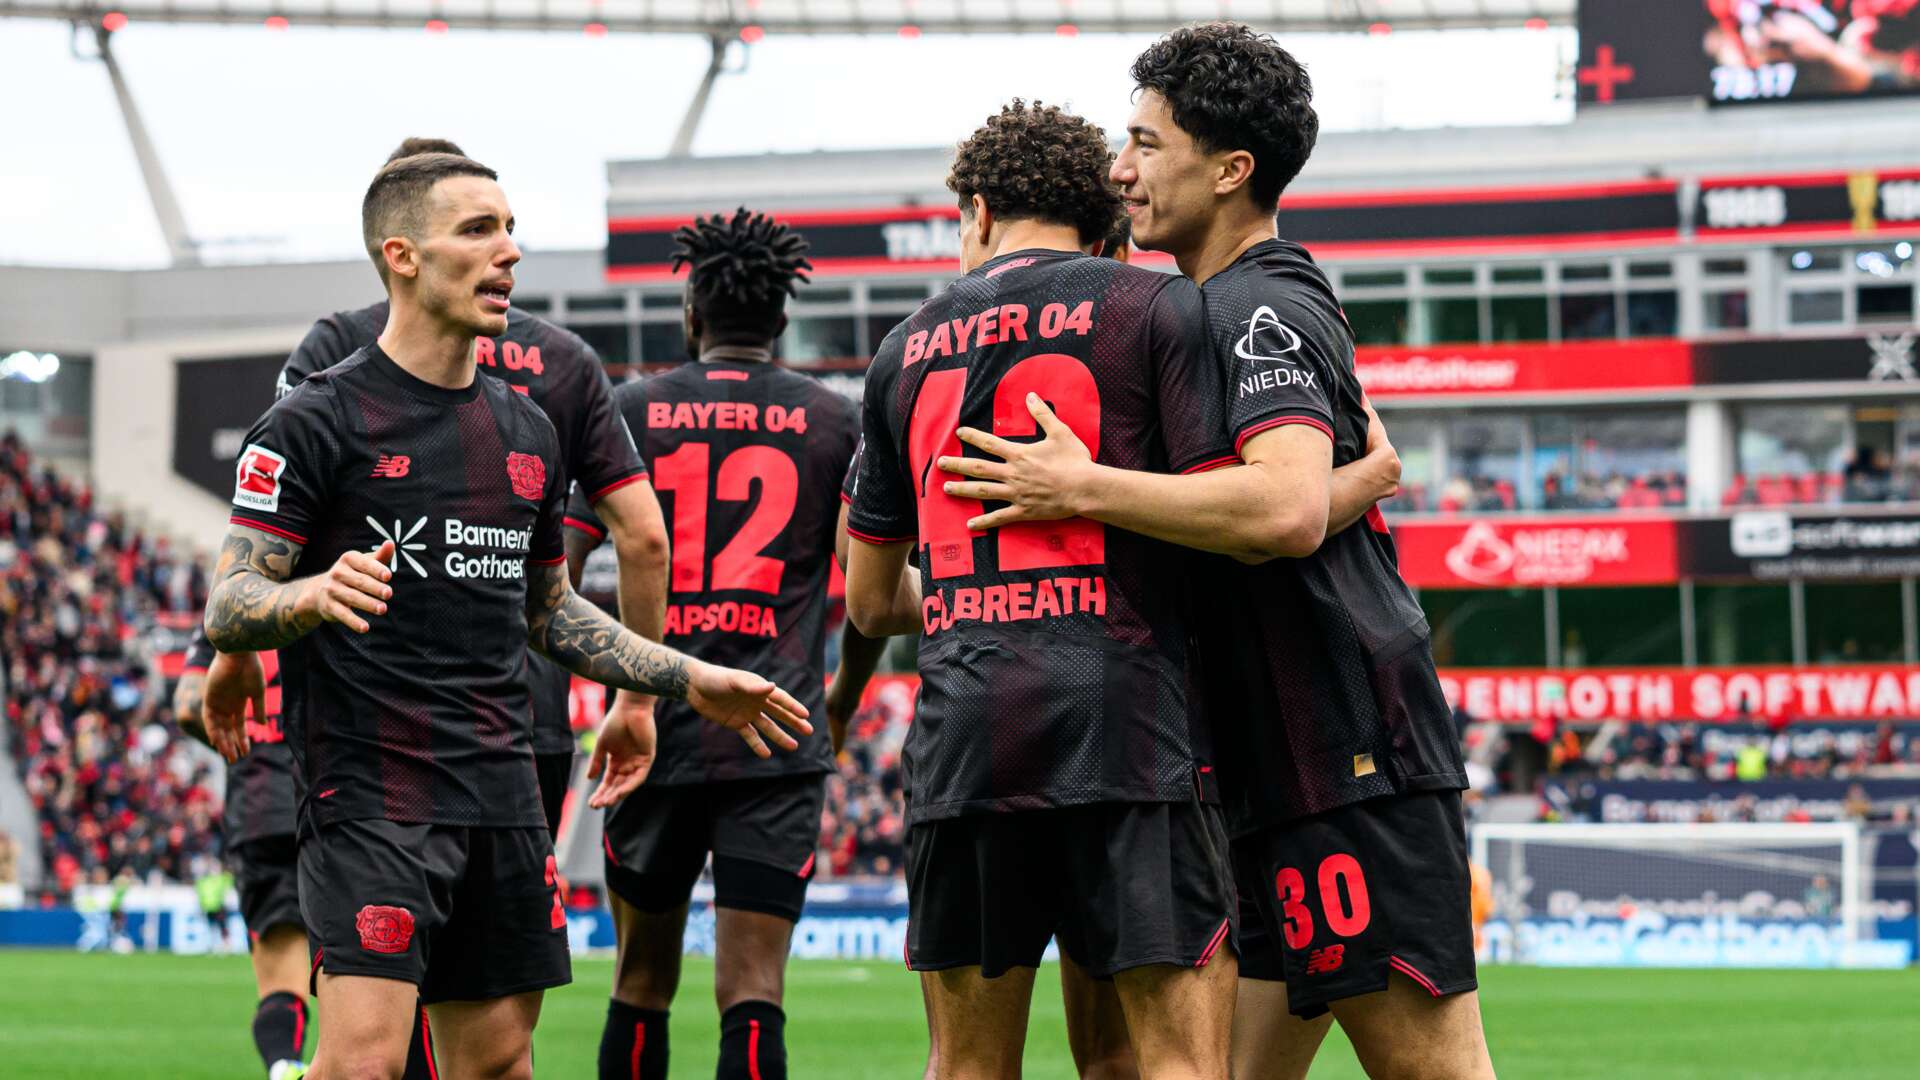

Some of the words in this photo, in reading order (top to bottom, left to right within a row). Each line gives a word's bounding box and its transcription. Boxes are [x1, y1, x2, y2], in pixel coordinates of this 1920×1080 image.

[903, 304, 1029, 369] BAYER
[1038, 301, 1094, 339] 04
[502, 341, 544, 375] 04
[1239, 367, 1318, 398] NIEDAX
[648, 402, 758, 431] BAYER
[764, 405, 807, 434] 04
[654, 442, 799, 595] 12
[445, 519, 532, 552] Barmeni
[445, 552, 525, 579] Gothaer
[1276, 853, 1371, 950] 30
